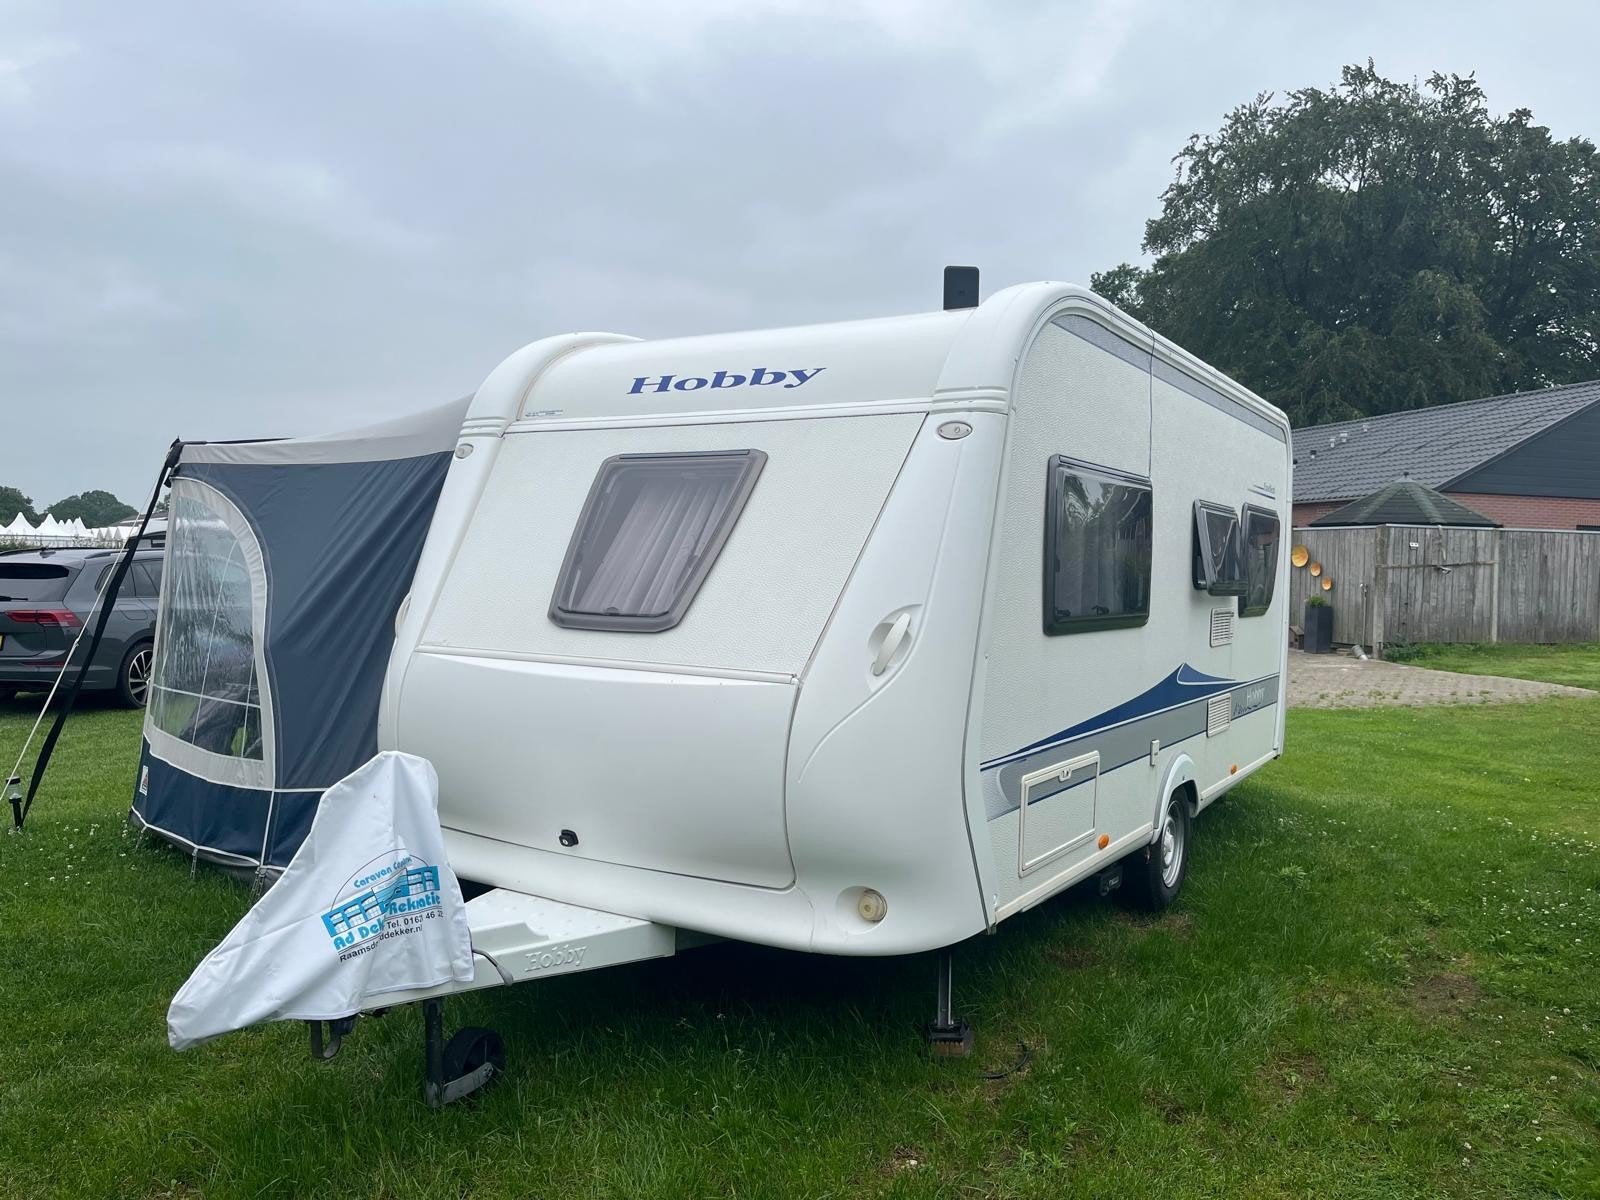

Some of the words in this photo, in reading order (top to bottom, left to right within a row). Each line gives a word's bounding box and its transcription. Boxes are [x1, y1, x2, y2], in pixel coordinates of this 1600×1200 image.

[626, 367, 826, 395] Hobby
[354, 867, 392, 888] Caravan
[386, 919, 402, 930] Tel.
[333, 931, 355, 951] Ad
[525, 944, 588, 973] Hobby
